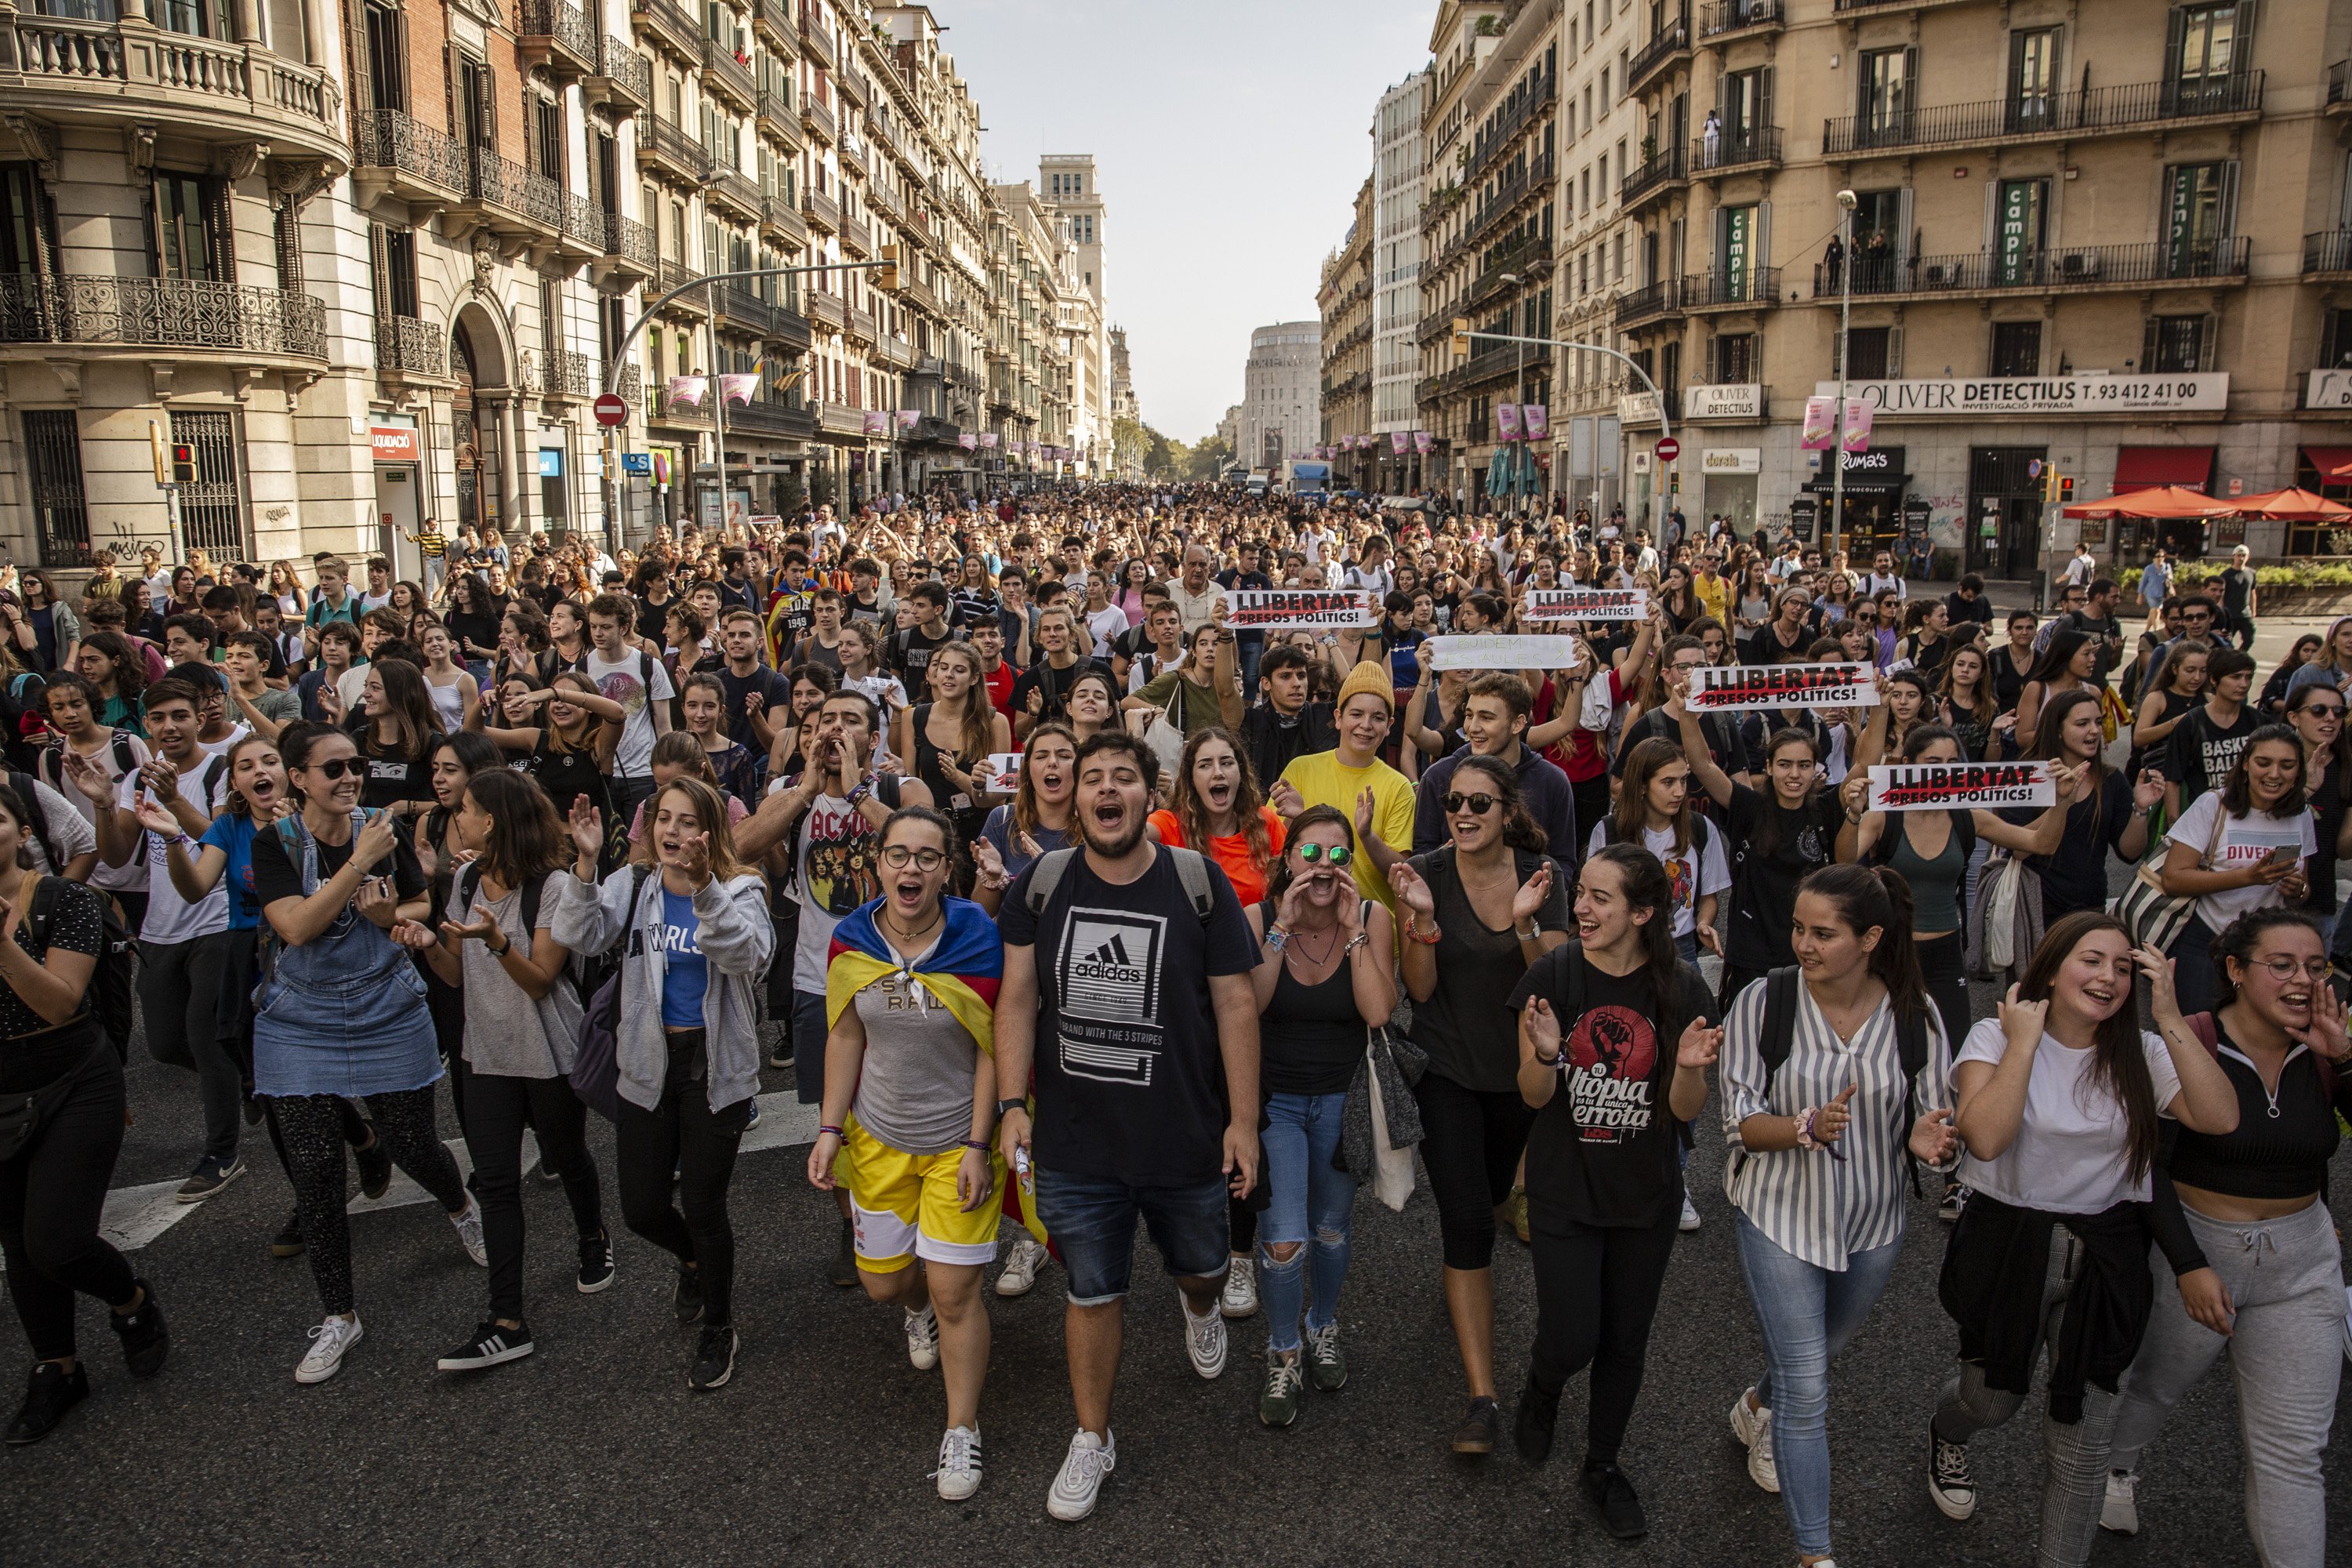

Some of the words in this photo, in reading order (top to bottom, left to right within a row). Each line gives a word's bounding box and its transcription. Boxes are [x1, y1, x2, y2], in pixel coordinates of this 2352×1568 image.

[2005, 190, 2022, 281] campus
[1730, 215, 1743, 297] campus
[1711, 388, 1749, 401] OLIVER
[1862, 384, 1955, 411] OLIVER
[1964, 383, 2075, 401] DETECTIUS
[2100, 385, 2117, 399] 93
[2122, 384, 2149, 398] 412
[2154, 384, 2171, 397] 41
[2177, 383, 2197, 397] 00
[1708, 403, 1753, 414] DETECTIUS
[1962, 401, 2028, 410] INVESTIGACIÓ
[372, 433, 409, 448] LIQUIDACIÓ
[1236, 593, 1358, 612] LLIBERTAT
[1535, 592, 1634, 606] LLIBERTAT
[1239, 613, 1290, 623] PRESOS
[1296, 611, 1359, 622] POLÍTICS!
[1582, 607, 1634, 616] POLÍTICS!
[788, 617, 807, 628] 1949
[1457, 637, 1523, 649] BUIDEM
[1434, 653, 1472, 666] LES
[1481, 653, 1543, 666] AULES
[1704, 666, 1858, 691] LLIBERTAT
[1705, 691, 1769, 705] PRESOS
[1776, 688, 1857, 703] POLÍTICS!
[1889, 765, 2034, 790] LLIBERTAT
[1889, 791, 1951, 804] PRESOS
[1957, 789, 2033, 803] POLÍTICS!
[1076, 962, 1140, 983] adidas
[1062, 1025, 1083, 1036] BRAND
[1085, 1028, 1106, 1039] WITH
[1107, 1029, 1123, 1040] THE
[1124, 1031, 1131, 1042] 3
[1131, 1032, 1163, 1046] STRIPES
[1604, 1100, 1628, 1109] única
[1572, 1105, 1650, 1127] errota
[1584, 1128, 1613, 1138] LDS
